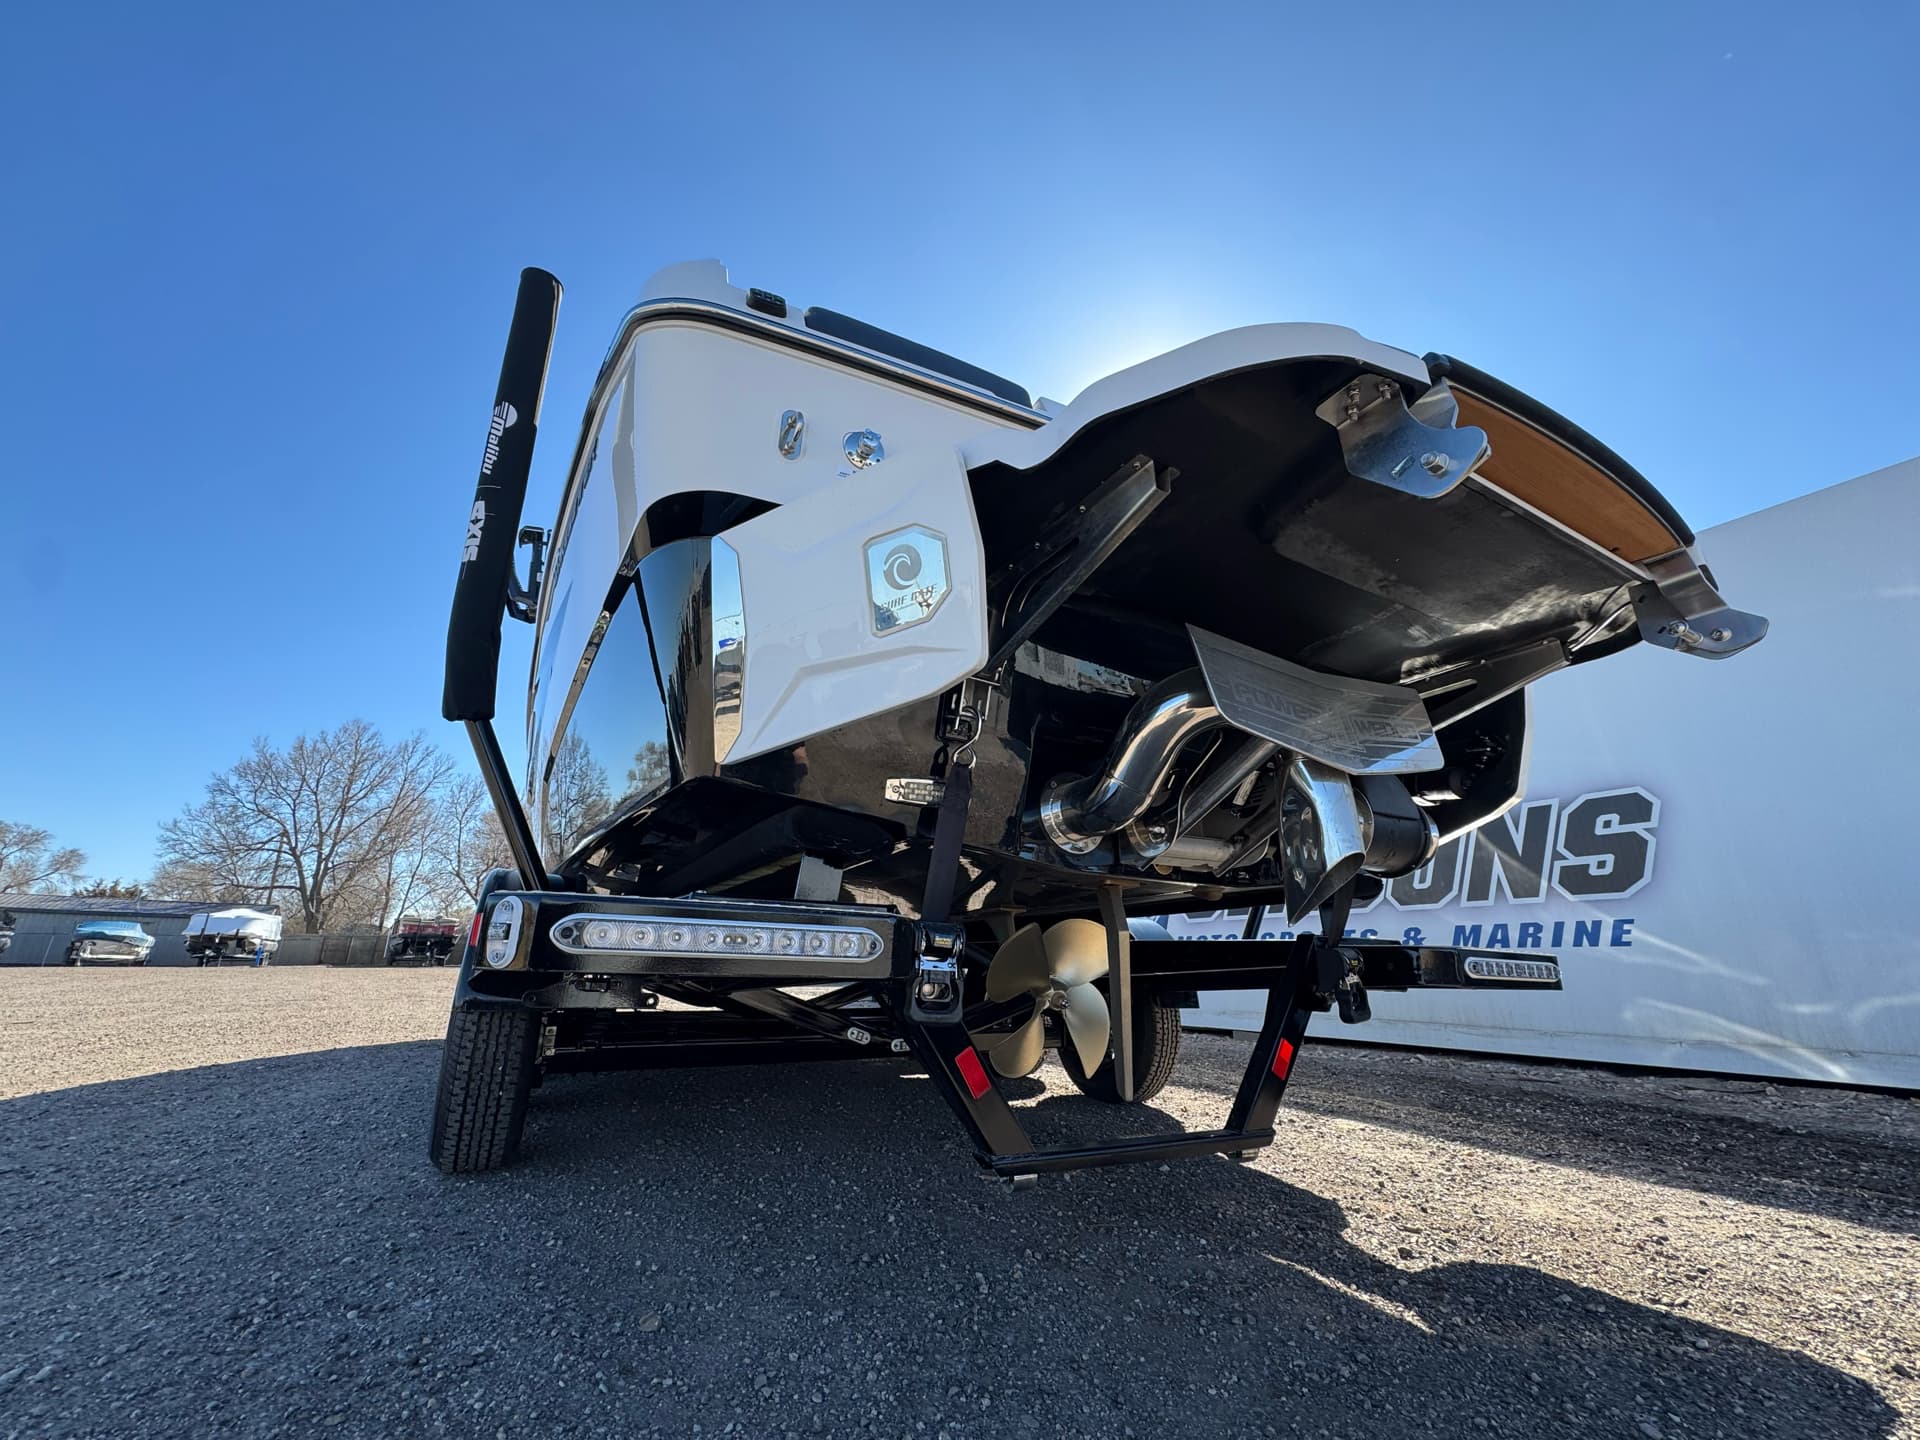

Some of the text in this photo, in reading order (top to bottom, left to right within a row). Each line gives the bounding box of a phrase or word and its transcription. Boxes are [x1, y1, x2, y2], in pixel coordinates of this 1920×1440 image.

[482, 416, 505, 475] malibu
[463, 500, 486, 562] AXIS
[1402, 926, 1427, 946] &
[1452, 918, 1635, 948] MARINE
